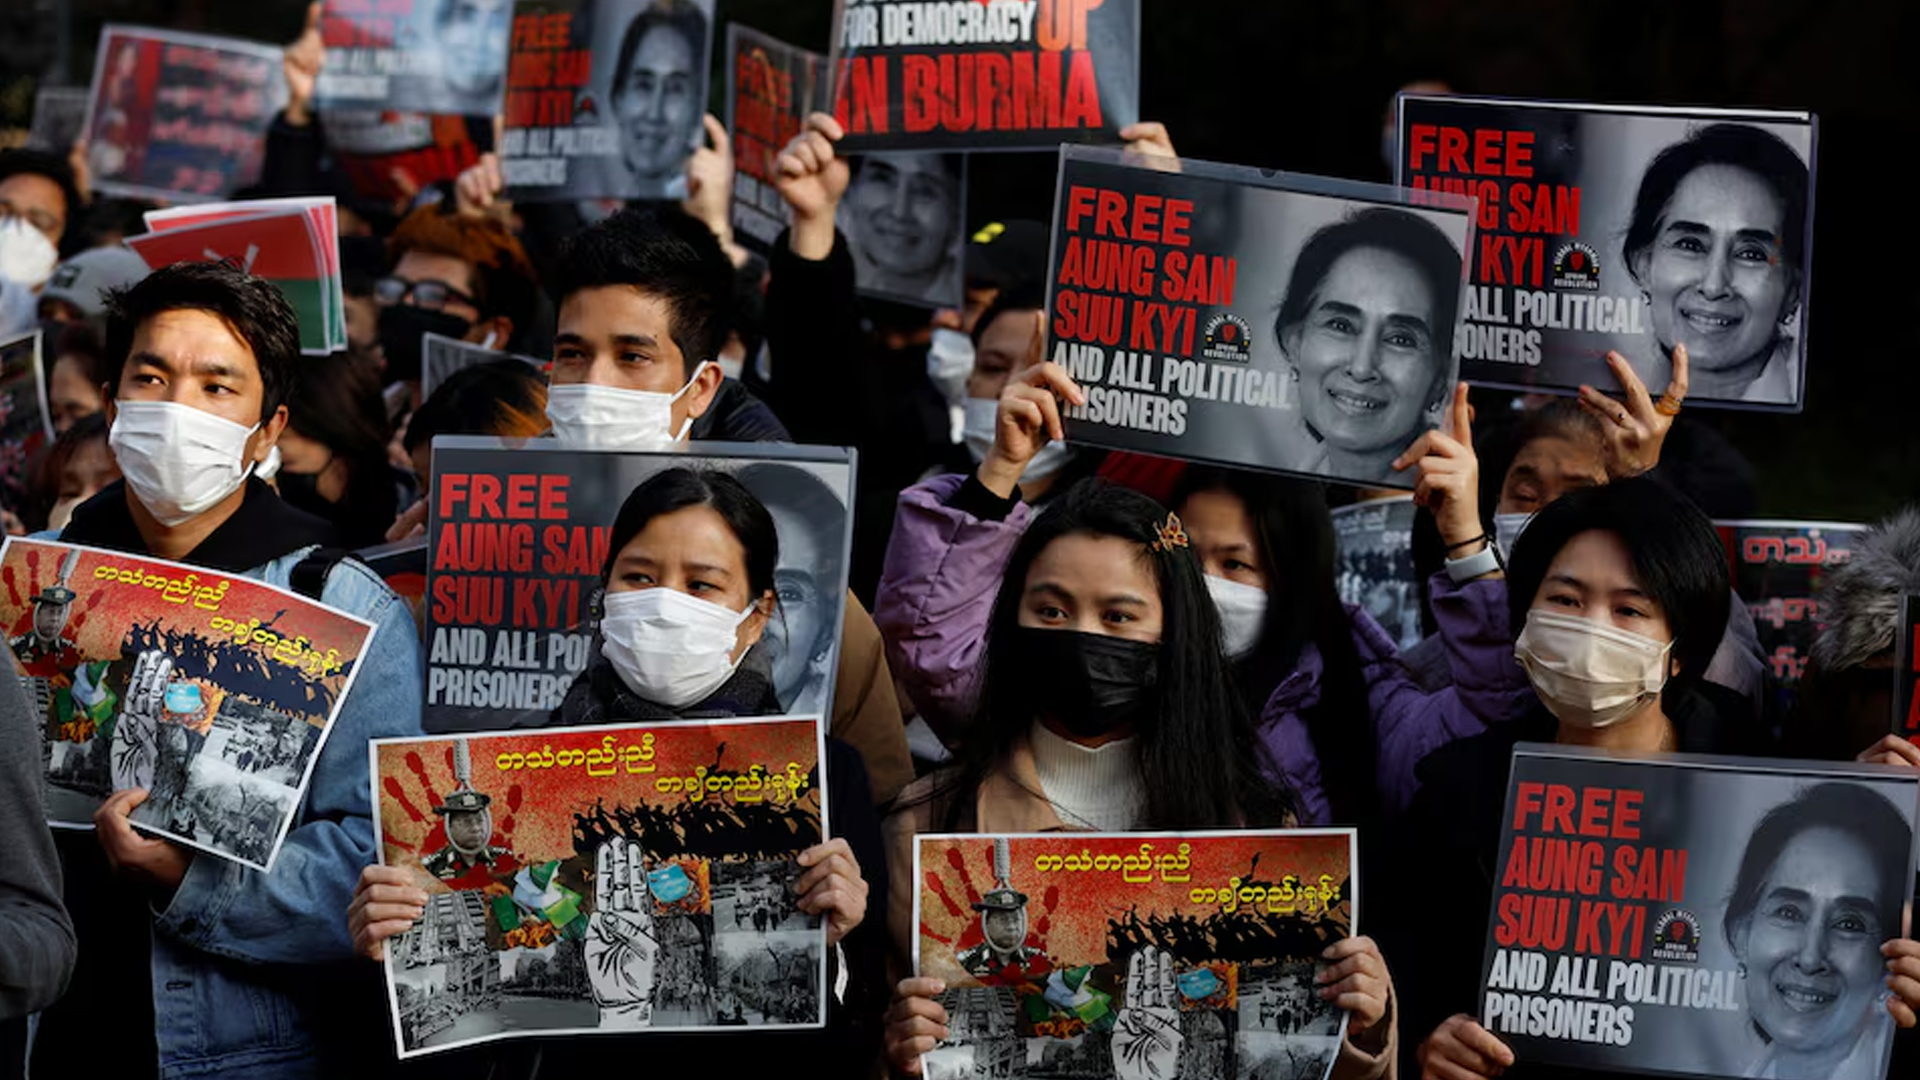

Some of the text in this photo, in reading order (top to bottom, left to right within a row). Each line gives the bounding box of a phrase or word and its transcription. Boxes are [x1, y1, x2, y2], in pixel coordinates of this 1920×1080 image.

[840, 0, 1037, 47] FOR DEMOCRACY
[833, 54, 889, 134] IN
[903, 51, 1104, 132] BURMA
[1409, 123, 1536, 179] FREE
[1066, 185, 1193, 246] FREE
[1507, 182, 1582, 237] SAN
[1059, 236, 1238, 307] AUNG SAN
[1480, 234, 1544, 288] KYI
[1053, 288, 1198, 358] SUU KYI
[1463, 284, 1645, 334] ALL POLITICAL
[1455, 320, 1541, 366] ONERS
[1053, 341, 1295, 411] AND ALL POLITICAL
[1062, 385, 1188, 437] ISONERS
[438, 473, 571, 520] FREE
[434, 522, 613, 576] AUNG SAN
[432, 575, 507, 627] SUU
[512, 579, 579, 630] KYI
[430, 626, 486, 668] AND
[491, 630, 540, 671] ALL
[428, 668, 574, 711] PRISONERS
[1512, 781, 1645, 840] FREE
[1502, 836, 1689, 903] AUNG SAN
[1494, 892, 1647, 960] SUU KYI
[1487, 948, 1740, 1012] AND ALL POLITICAL
[1483, 991, 1635, 1047] PRISONERS
